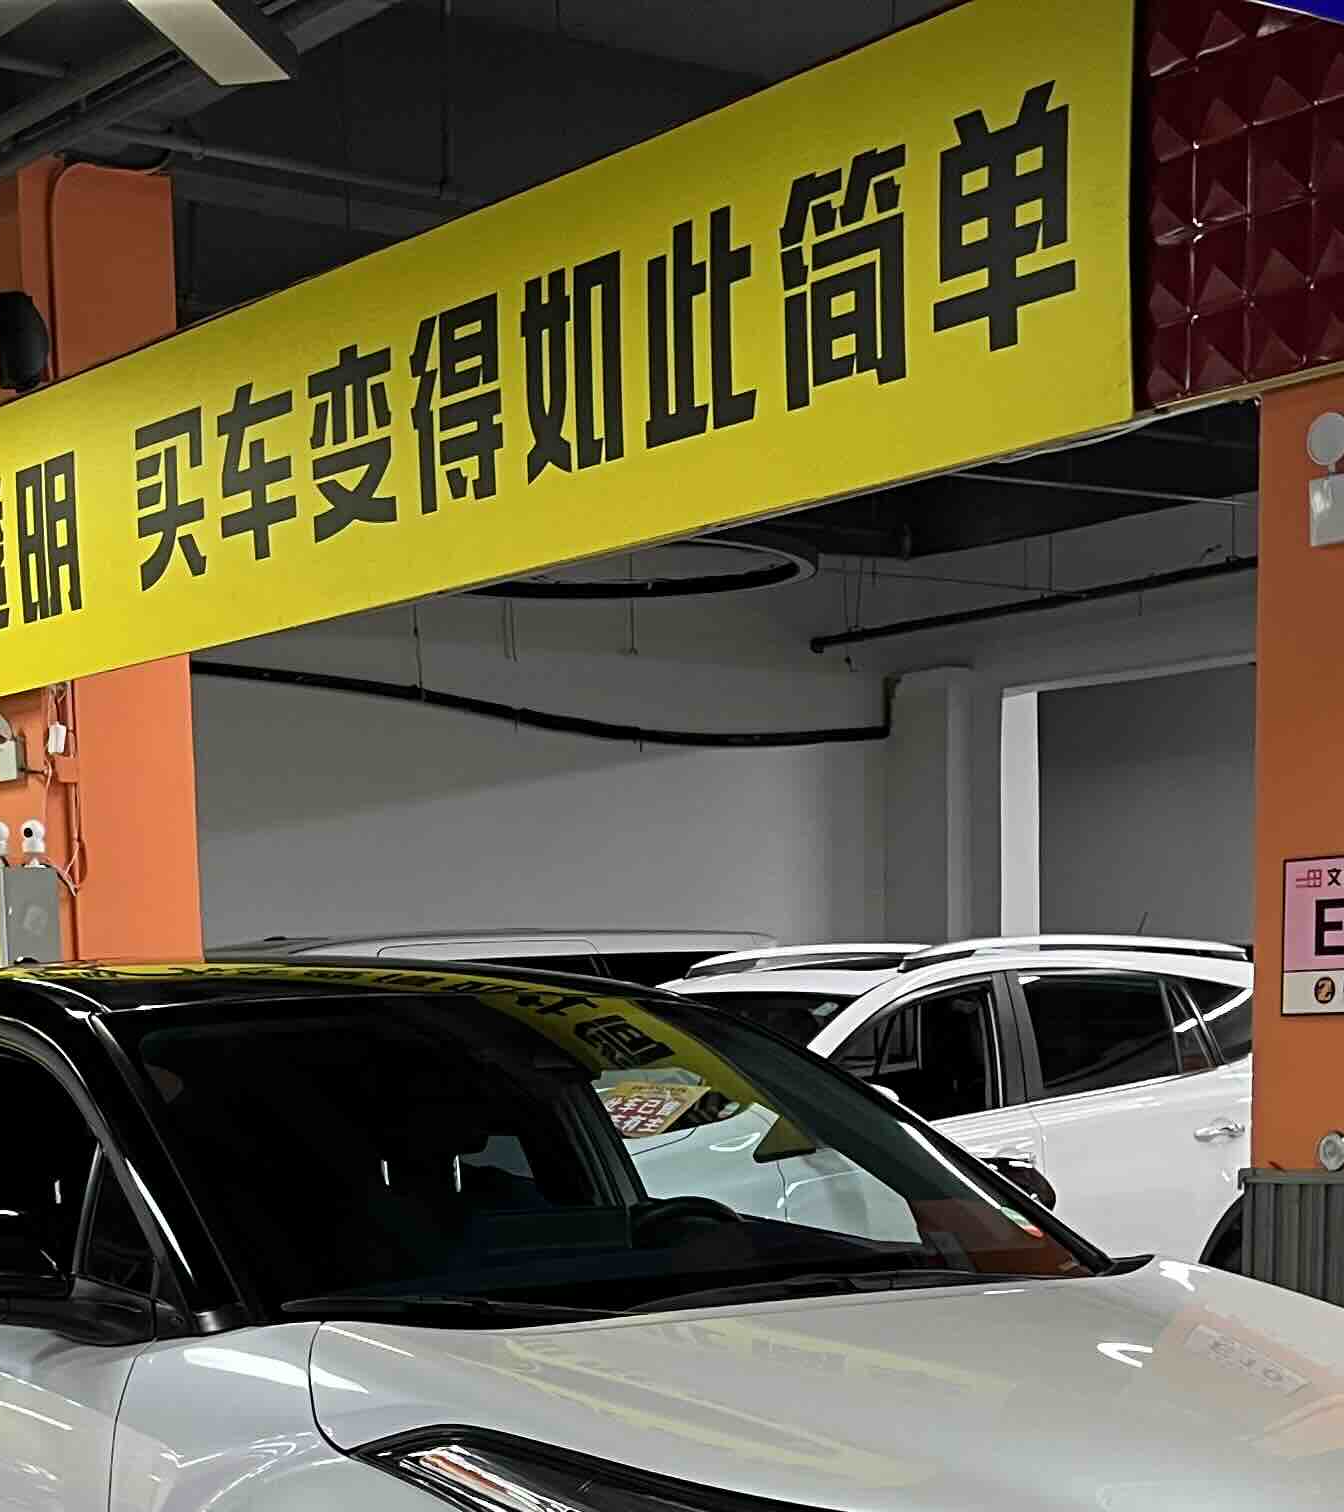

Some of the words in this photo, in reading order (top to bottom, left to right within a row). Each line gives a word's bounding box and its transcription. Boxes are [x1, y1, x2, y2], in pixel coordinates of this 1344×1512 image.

[134, 79, 1077, 592] 买车变得如此简单
